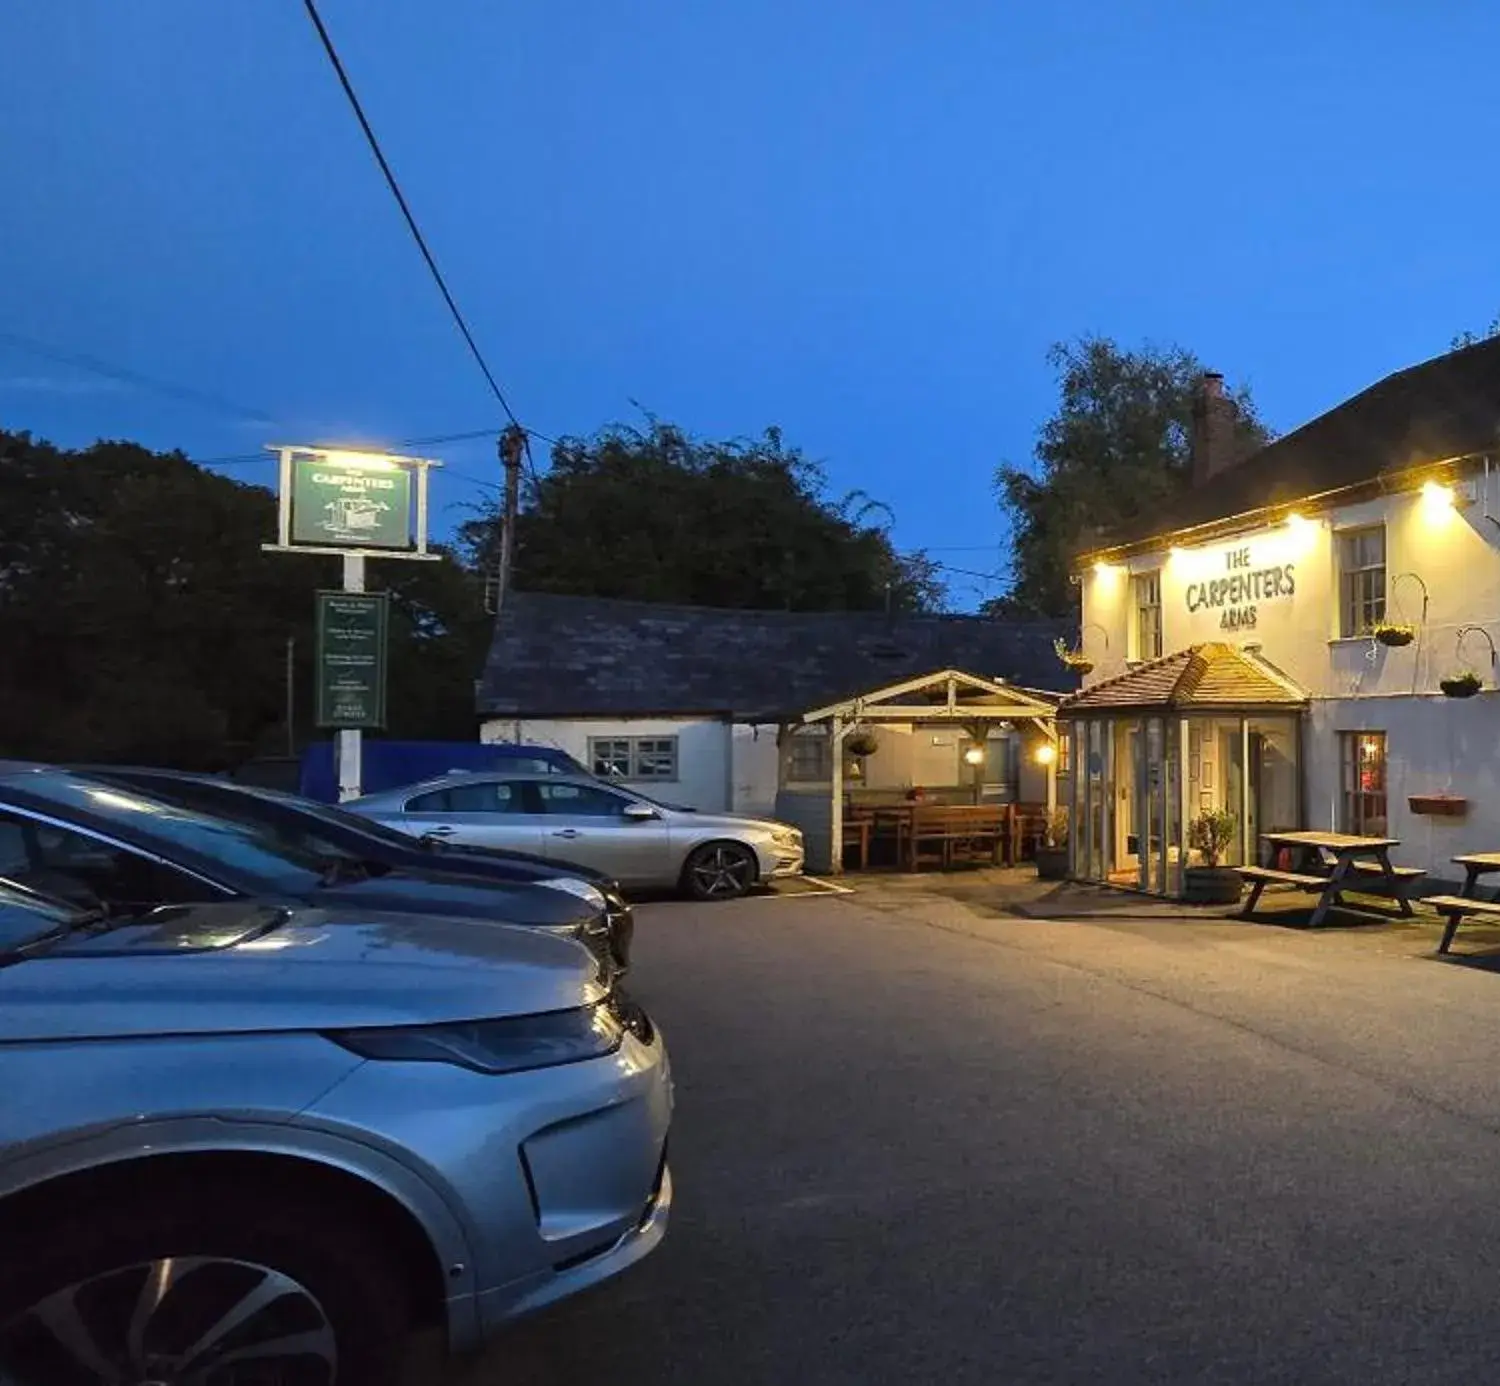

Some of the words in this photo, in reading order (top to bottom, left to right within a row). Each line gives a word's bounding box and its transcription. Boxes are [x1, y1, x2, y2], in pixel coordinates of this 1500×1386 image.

[312, 472, 395, 489] CARPENTERS
[1224, 547, 1250, 570] THE
[1186, 563, 1296, 614] CARPENTERS
[1219, 605, 1257, 630] ARMS
